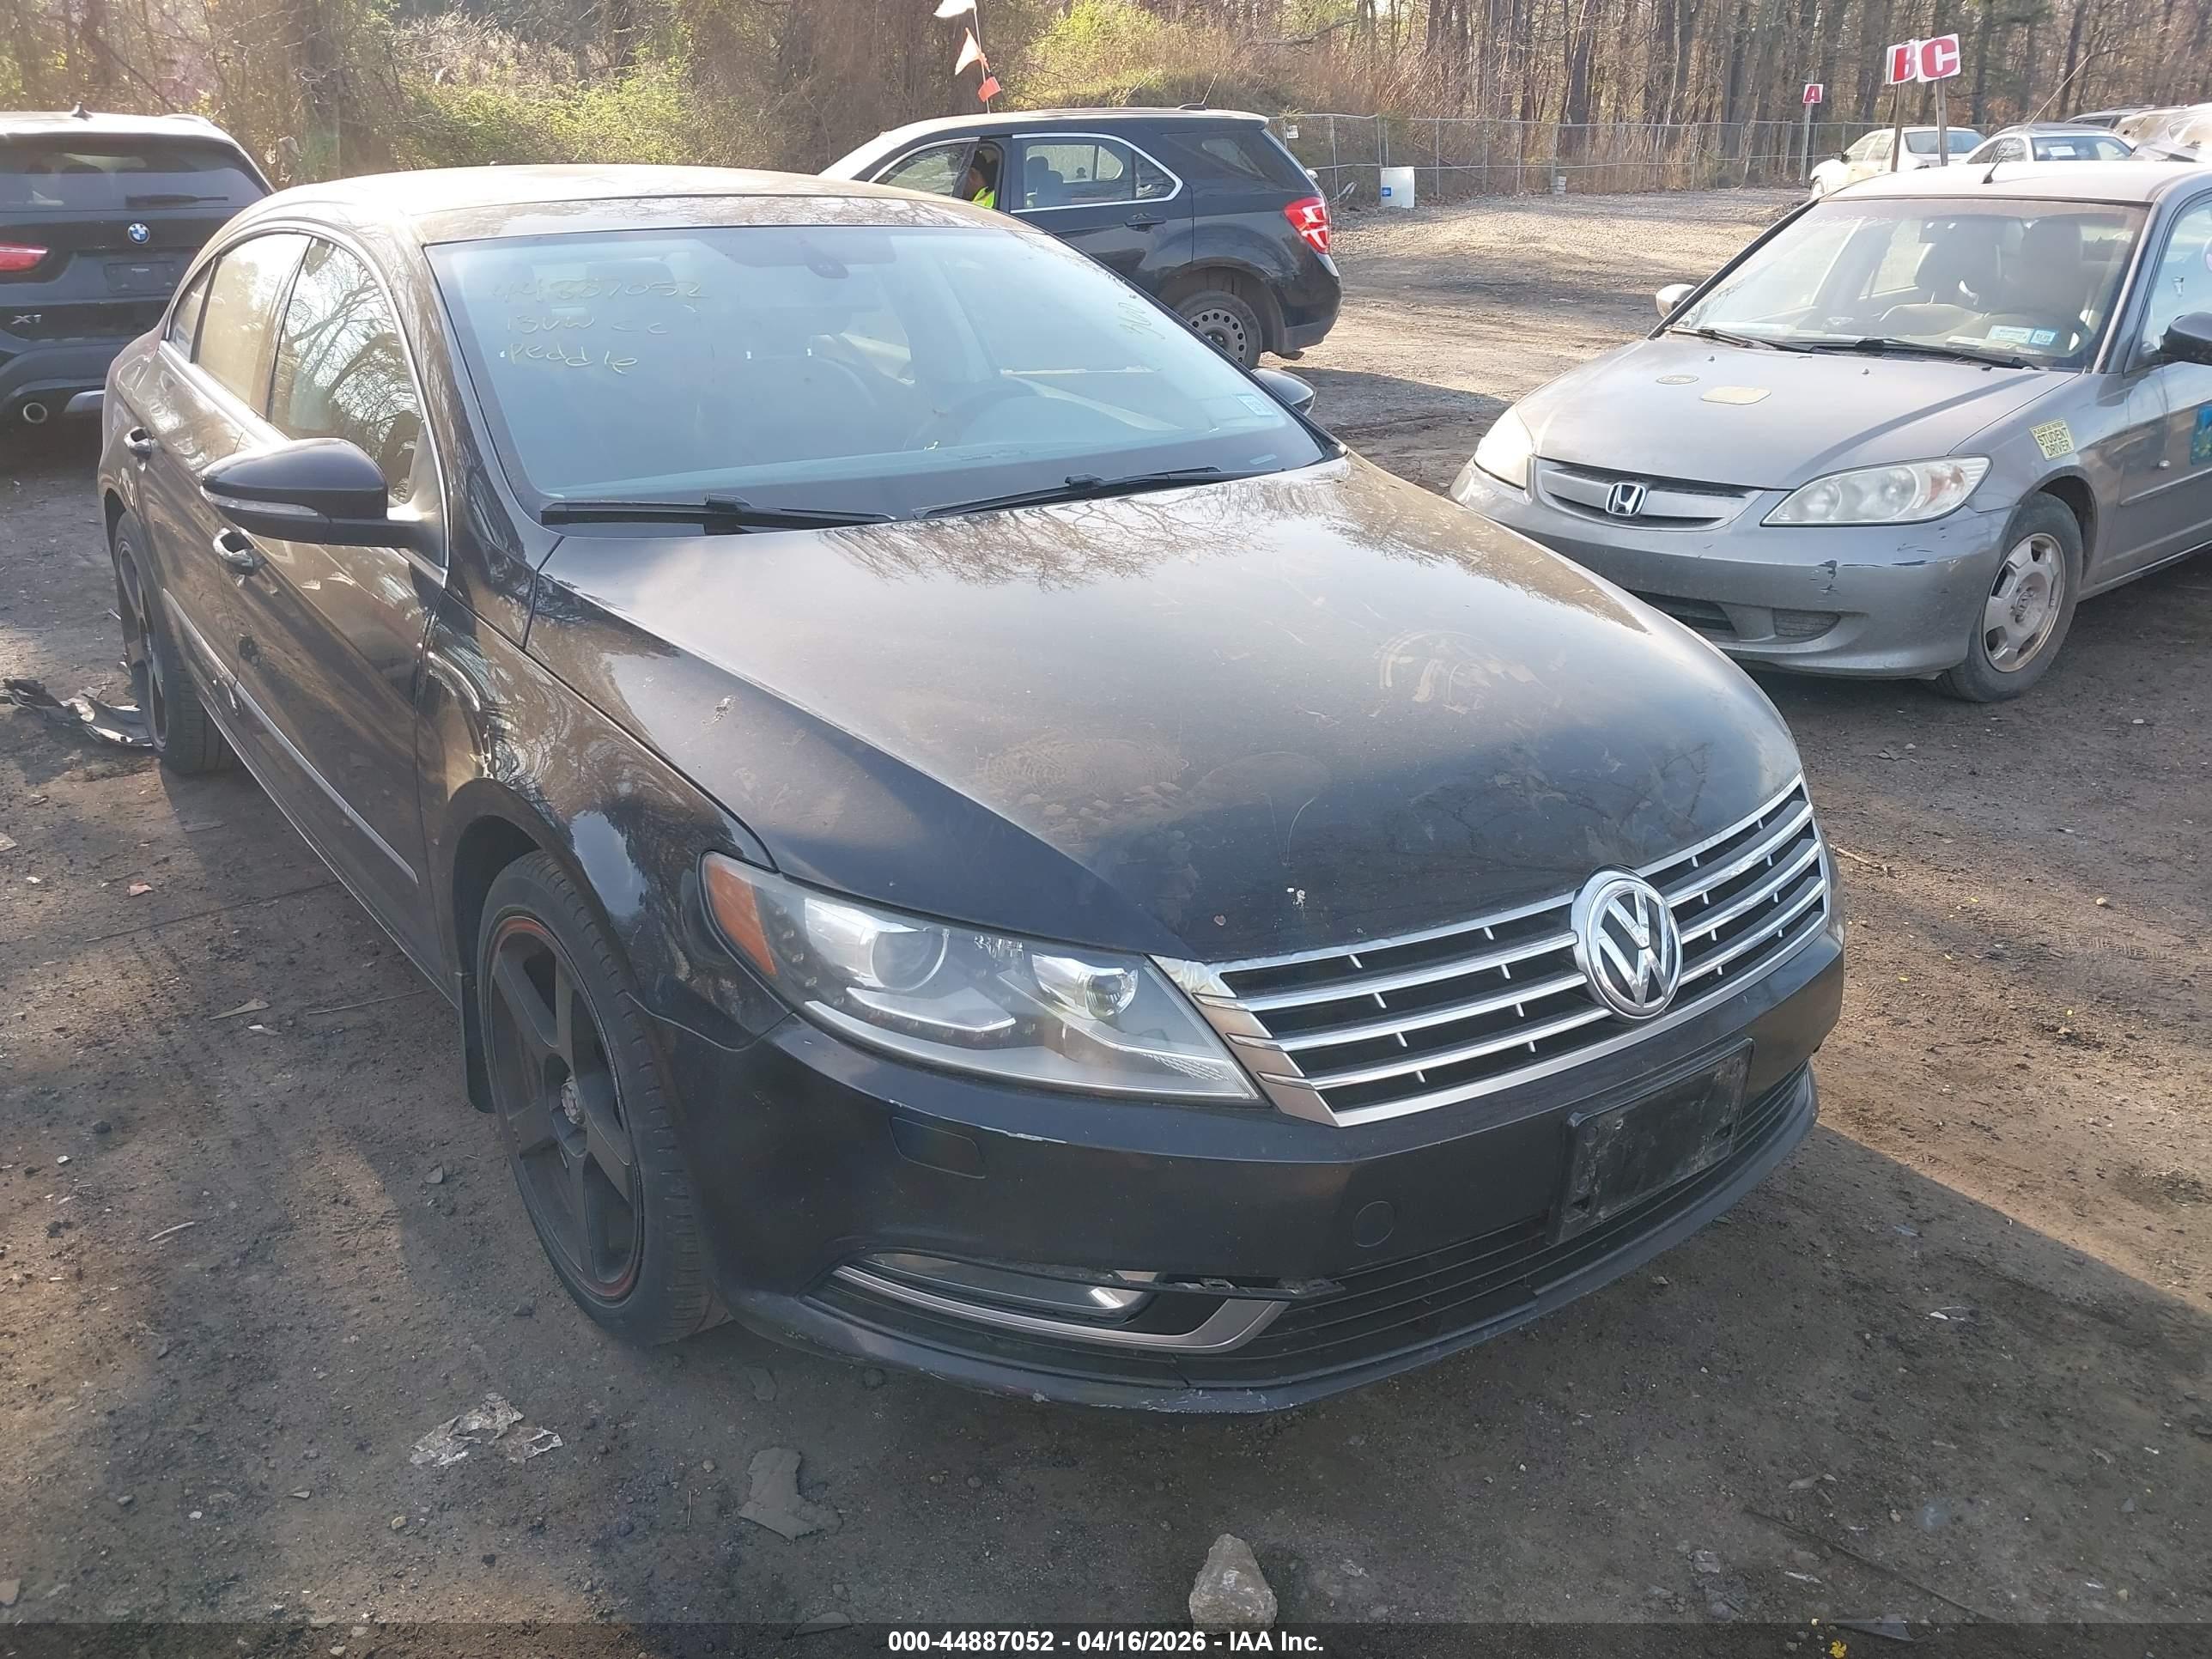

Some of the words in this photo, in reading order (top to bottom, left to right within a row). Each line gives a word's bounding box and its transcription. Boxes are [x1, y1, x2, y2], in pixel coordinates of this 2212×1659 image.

[1922, 39, 1958, 78] C
[1804, 86, 1820, 101] A
[2037, 427, 2068, 446] STUDENT
[2045, 440, 2070, 456] DRIVER
